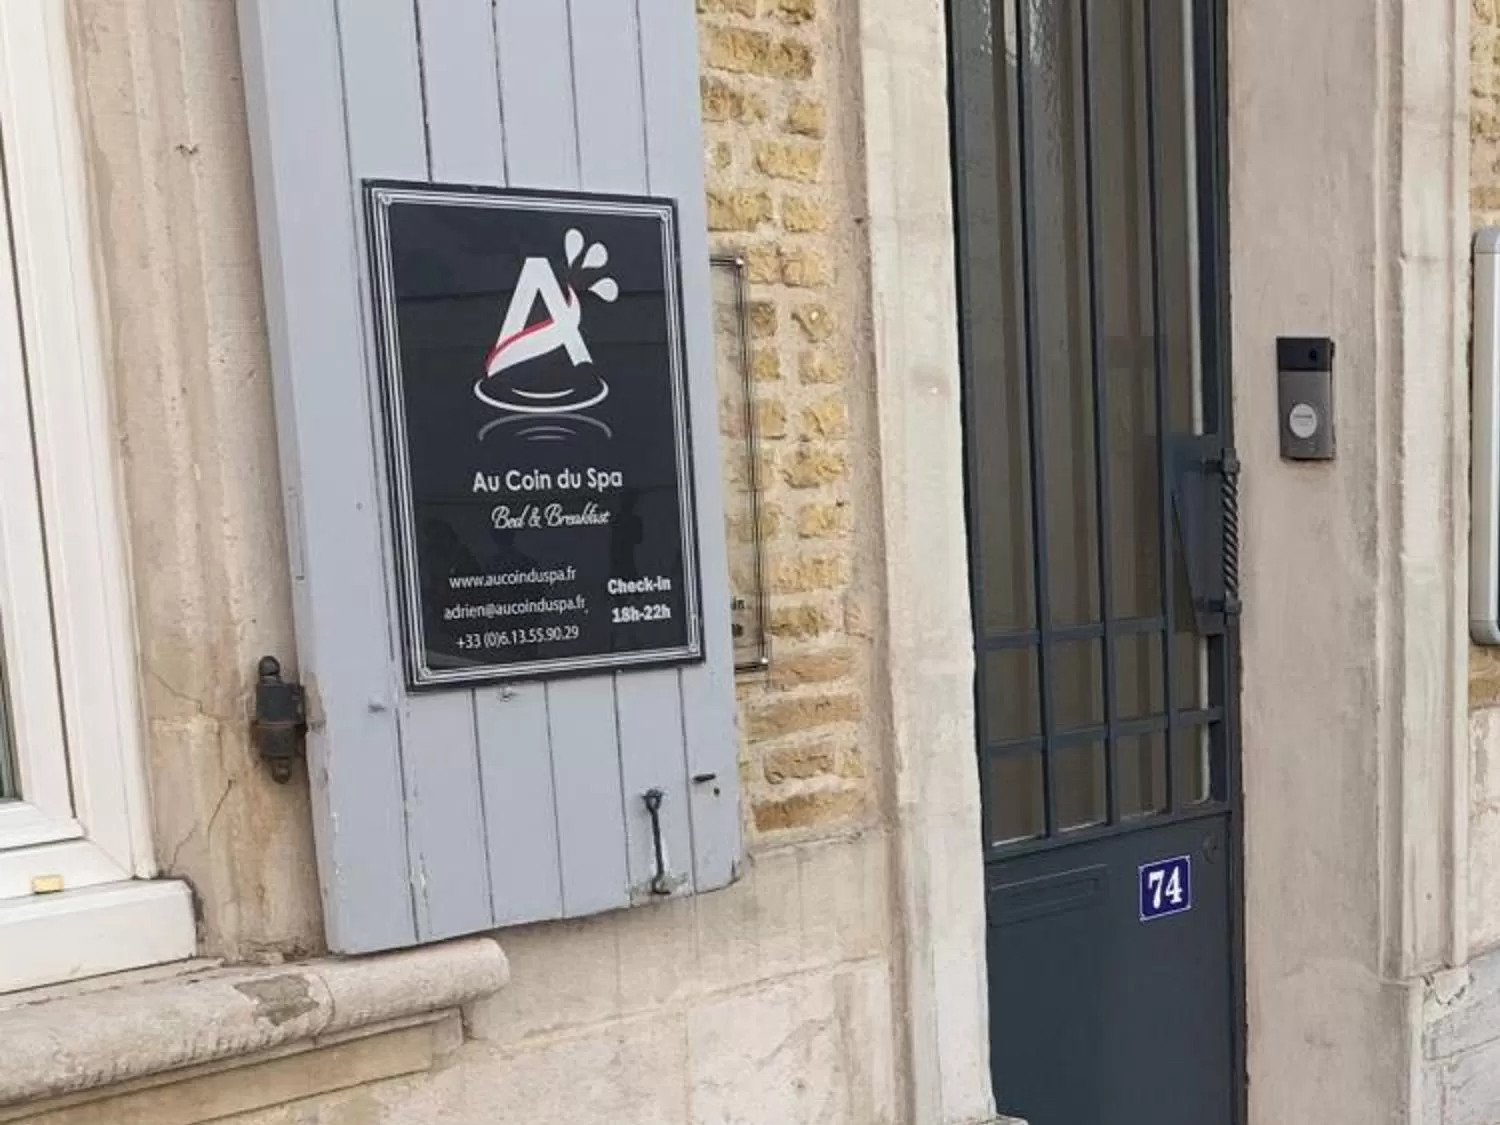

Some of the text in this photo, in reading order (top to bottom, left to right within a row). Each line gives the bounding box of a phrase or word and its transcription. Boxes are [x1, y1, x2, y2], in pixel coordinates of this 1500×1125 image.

[472, 467, 623, 493] Au Coin du Spa
[491, 501, 611, 529] Bed & Breakfast
[448, 565, 577, 589] www.aucoinduspa.fr
[443, 593, 585, 620] adrien@aucoinduspa.fr
[611, 603, 672, 623] 18h-22h
[455, 632, 481, 649] +33
[1148, 865, 1183, 909] 74
